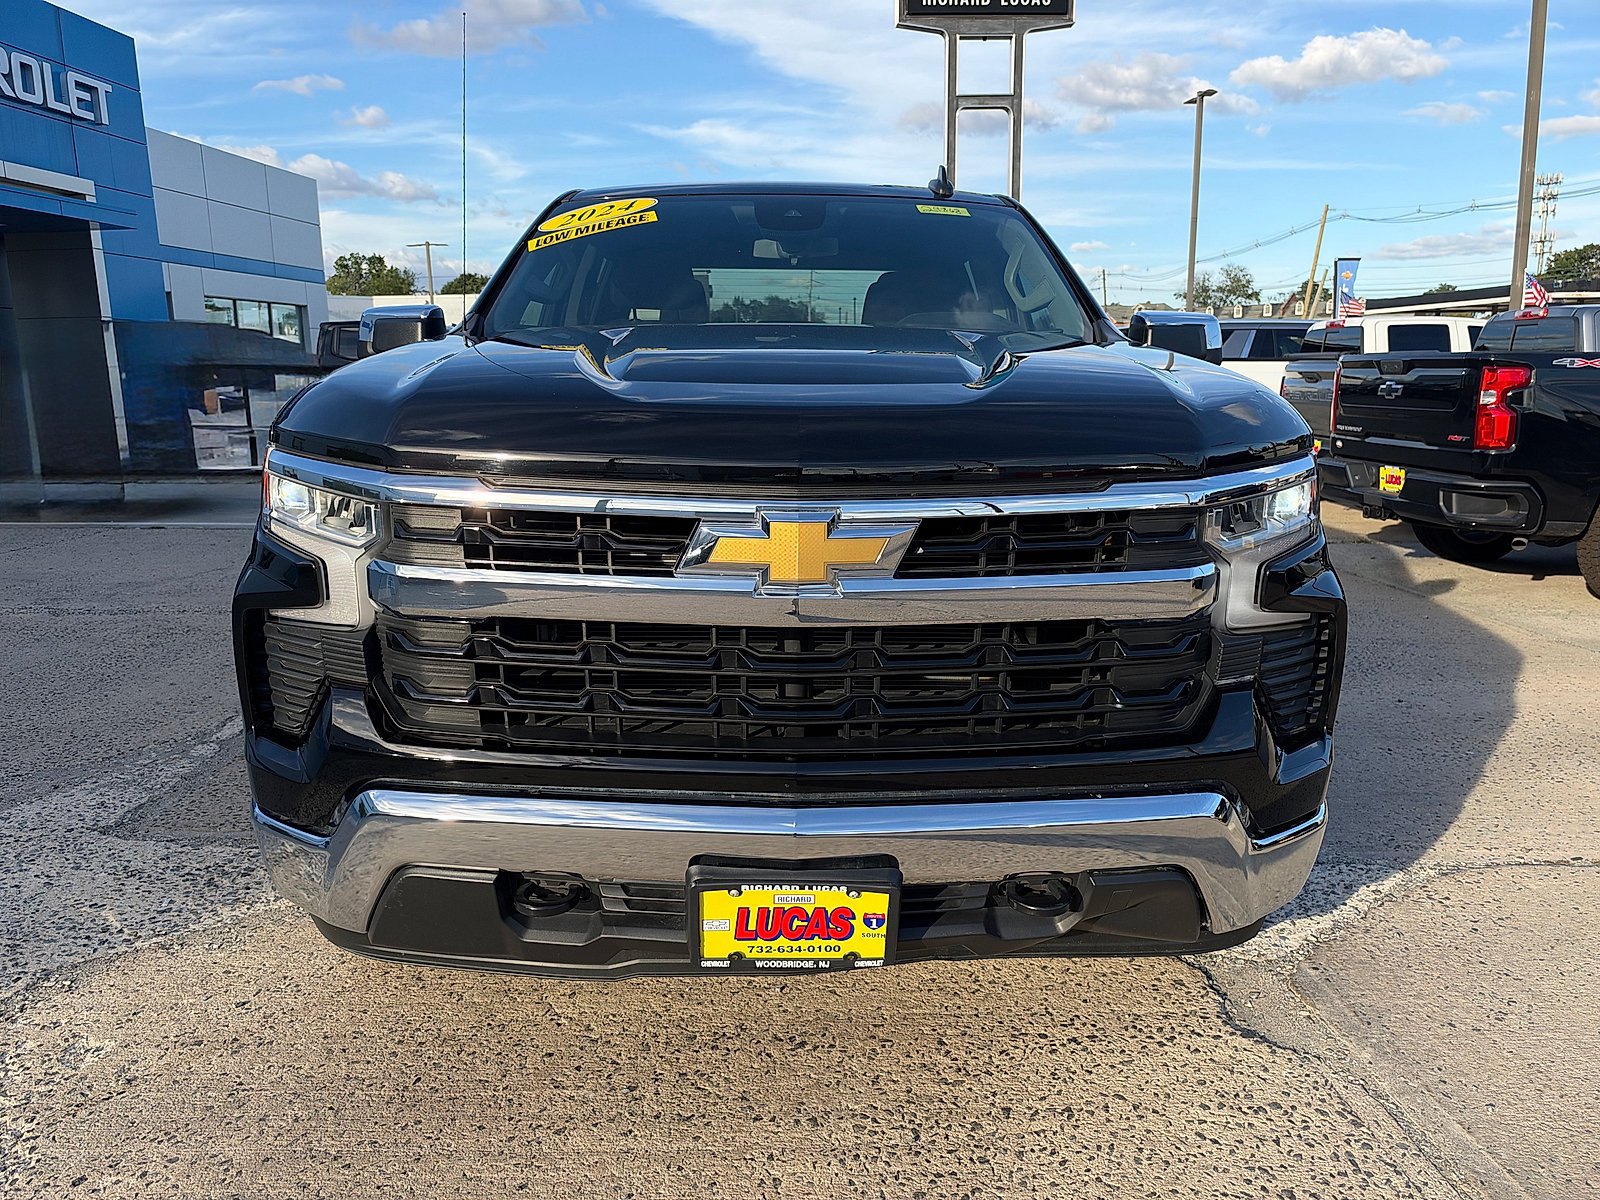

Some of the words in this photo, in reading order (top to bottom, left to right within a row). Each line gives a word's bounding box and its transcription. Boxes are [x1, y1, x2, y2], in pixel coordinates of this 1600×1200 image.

[558, 200, 638, 227] 2024
[534, 230, 571, 249] LOW
[575, 213, 649, 237] MILEAGE
[741, 884, 800, 892] RICHARD
[804, 885, 848, 893] LUCAS
[734, 906, 856, 941] LUCAS
[869, 918, 879, 929] 1
[747, 945, 841, 953] 732-634-0100
[819, 960, 830, 968] NJ
